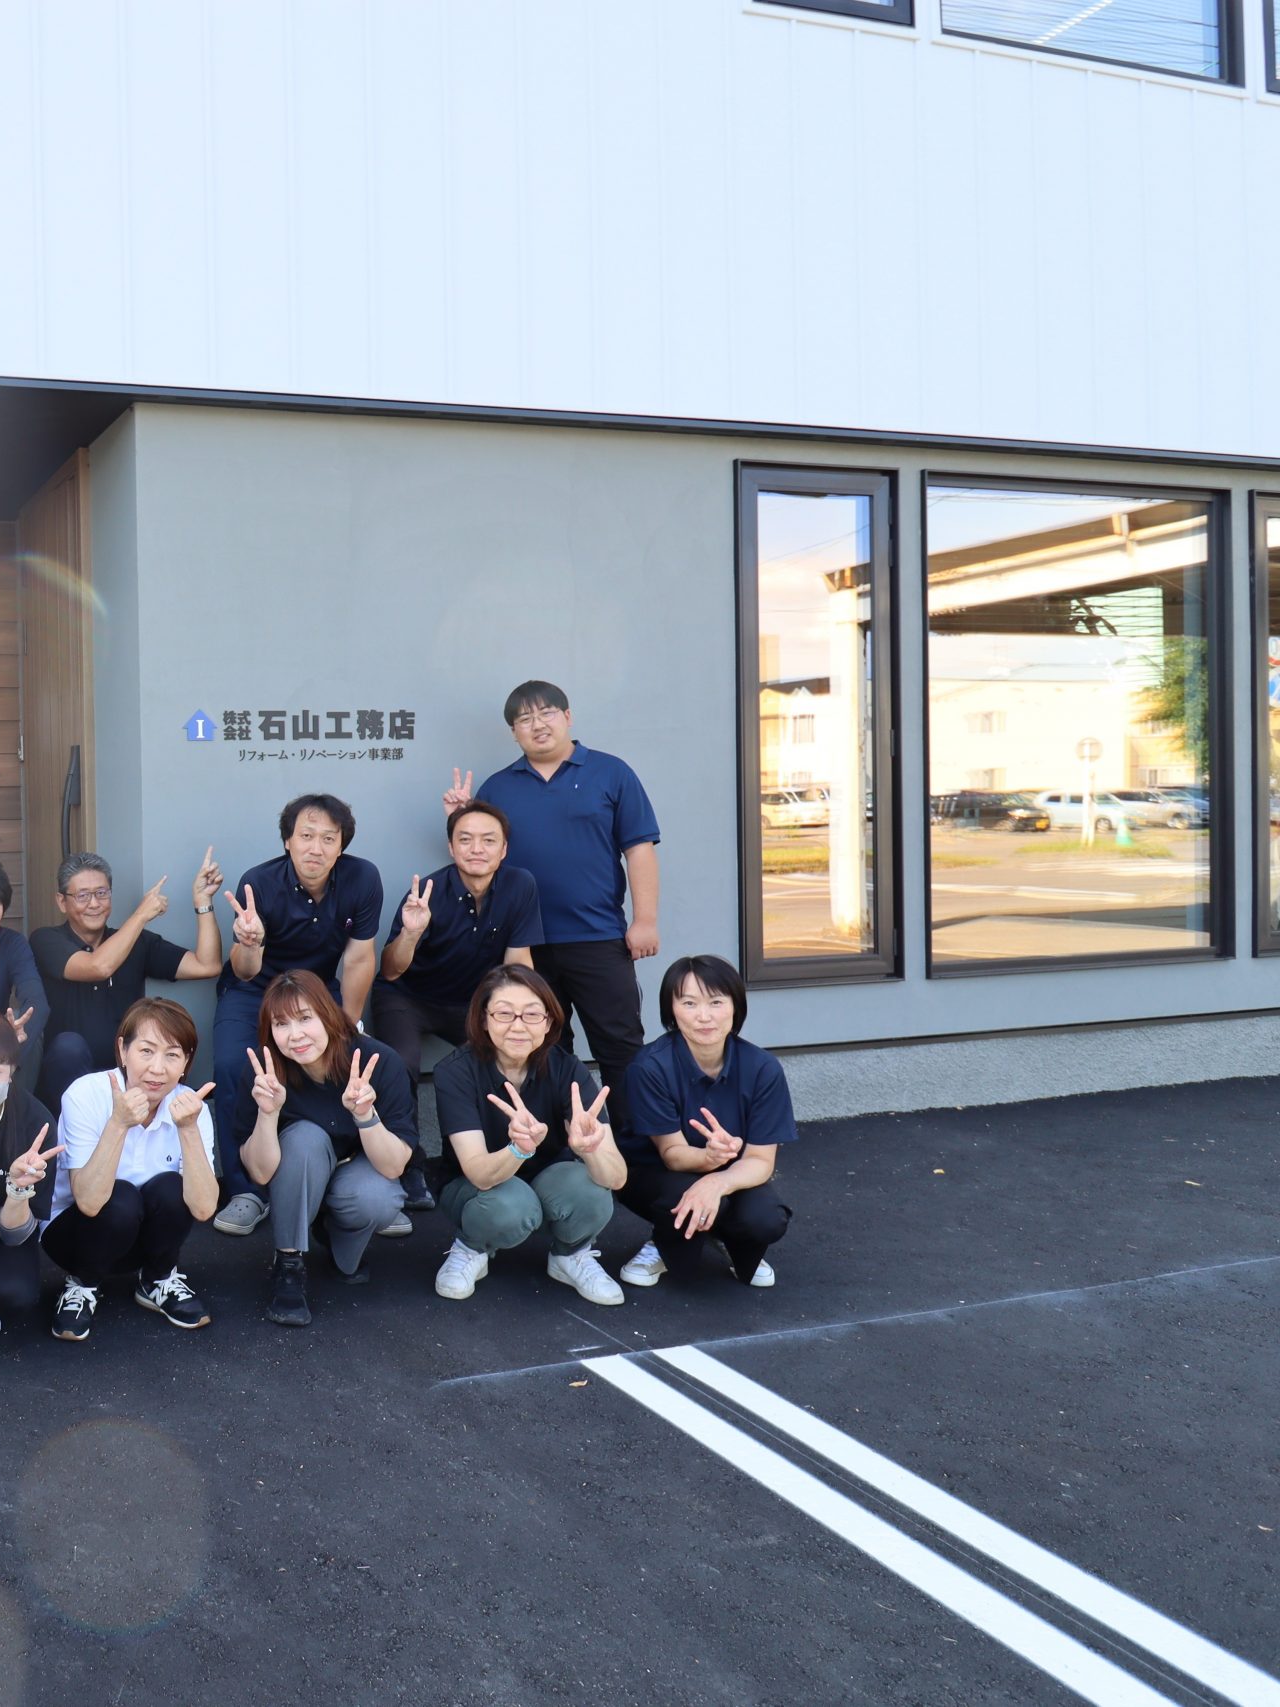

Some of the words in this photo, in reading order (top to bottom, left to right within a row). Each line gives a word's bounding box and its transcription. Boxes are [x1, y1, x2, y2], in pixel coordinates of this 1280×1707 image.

[258, 709, 416, 741] 石山工務店
[238, 748, 404, 761] リフォーム・リノベーション事業部
